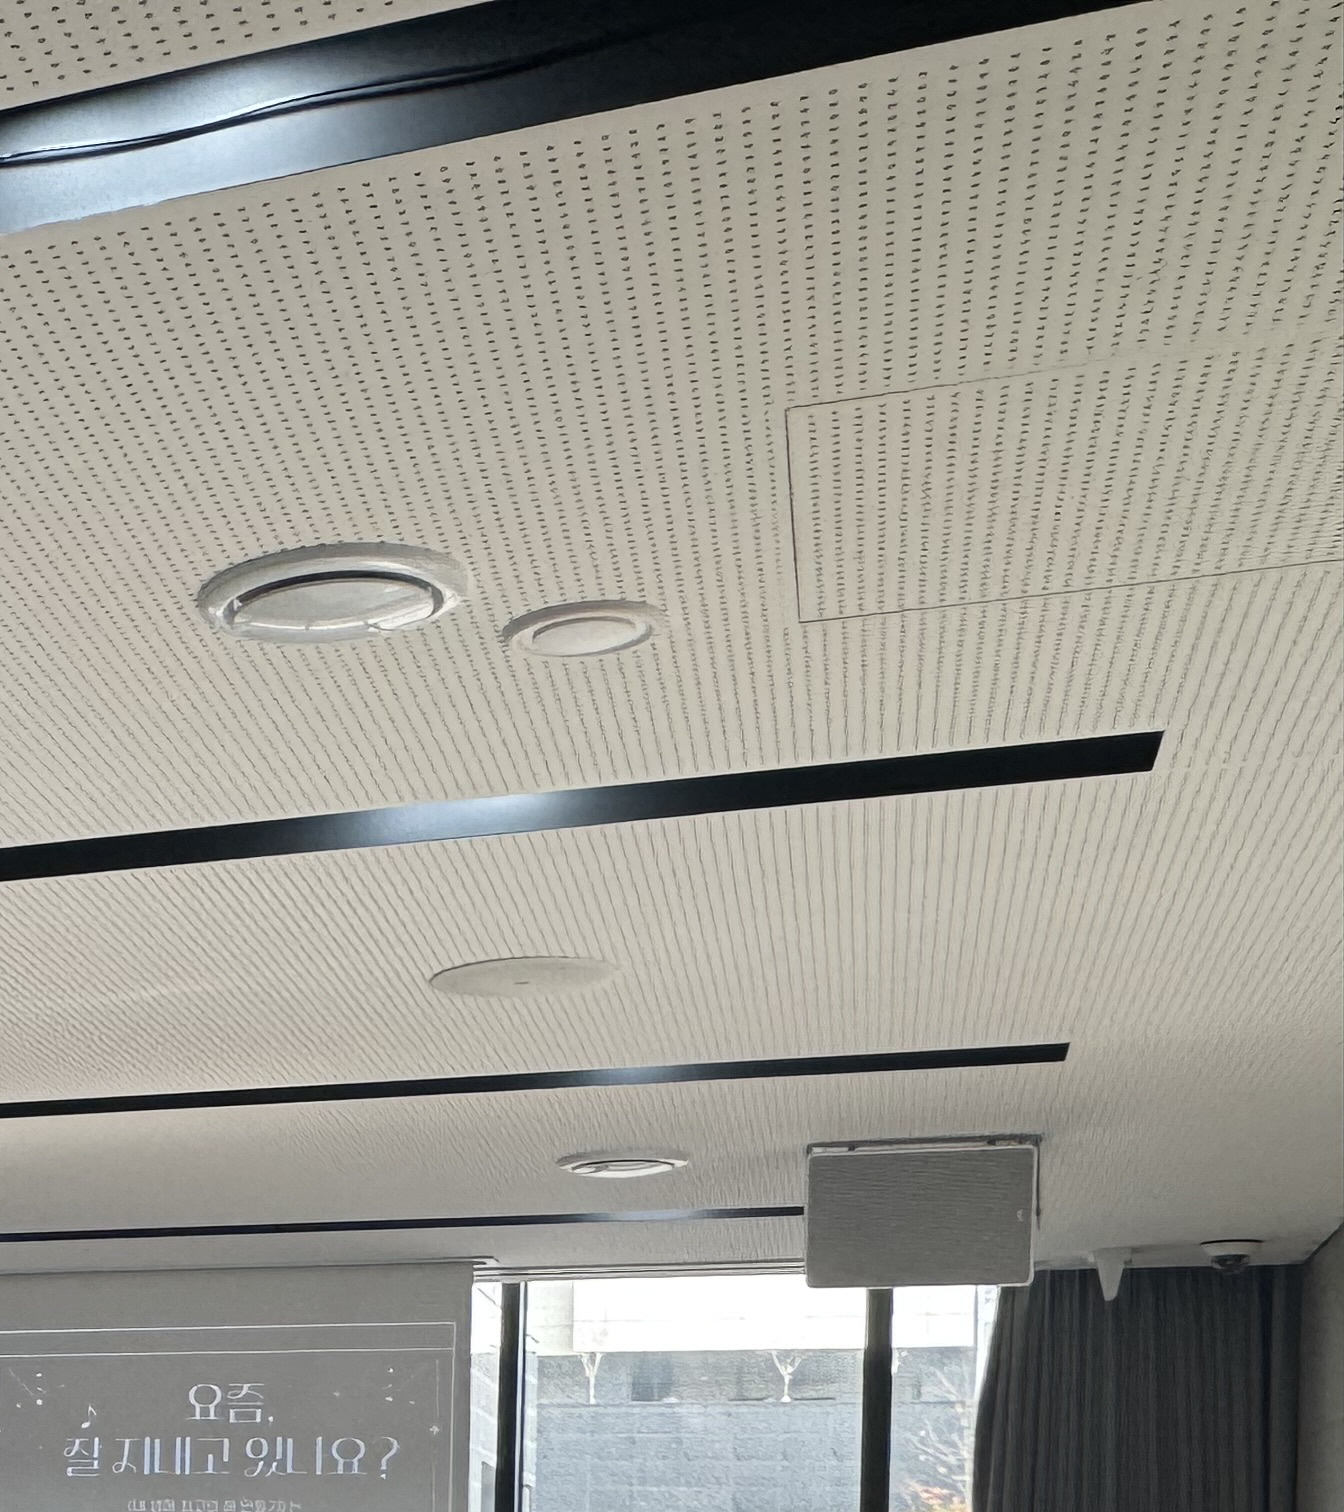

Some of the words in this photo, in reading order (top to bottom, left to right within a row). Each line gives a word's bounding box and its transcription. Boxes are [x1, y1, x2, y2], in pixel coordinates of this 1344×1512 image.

[185, 1383, 274, 1424] 요즘,
[63, 1436, 102, 1478] 잘
[111, 1436, 231, 1475] 지내고
[244, 1436, 401, 1480] 있나요?
